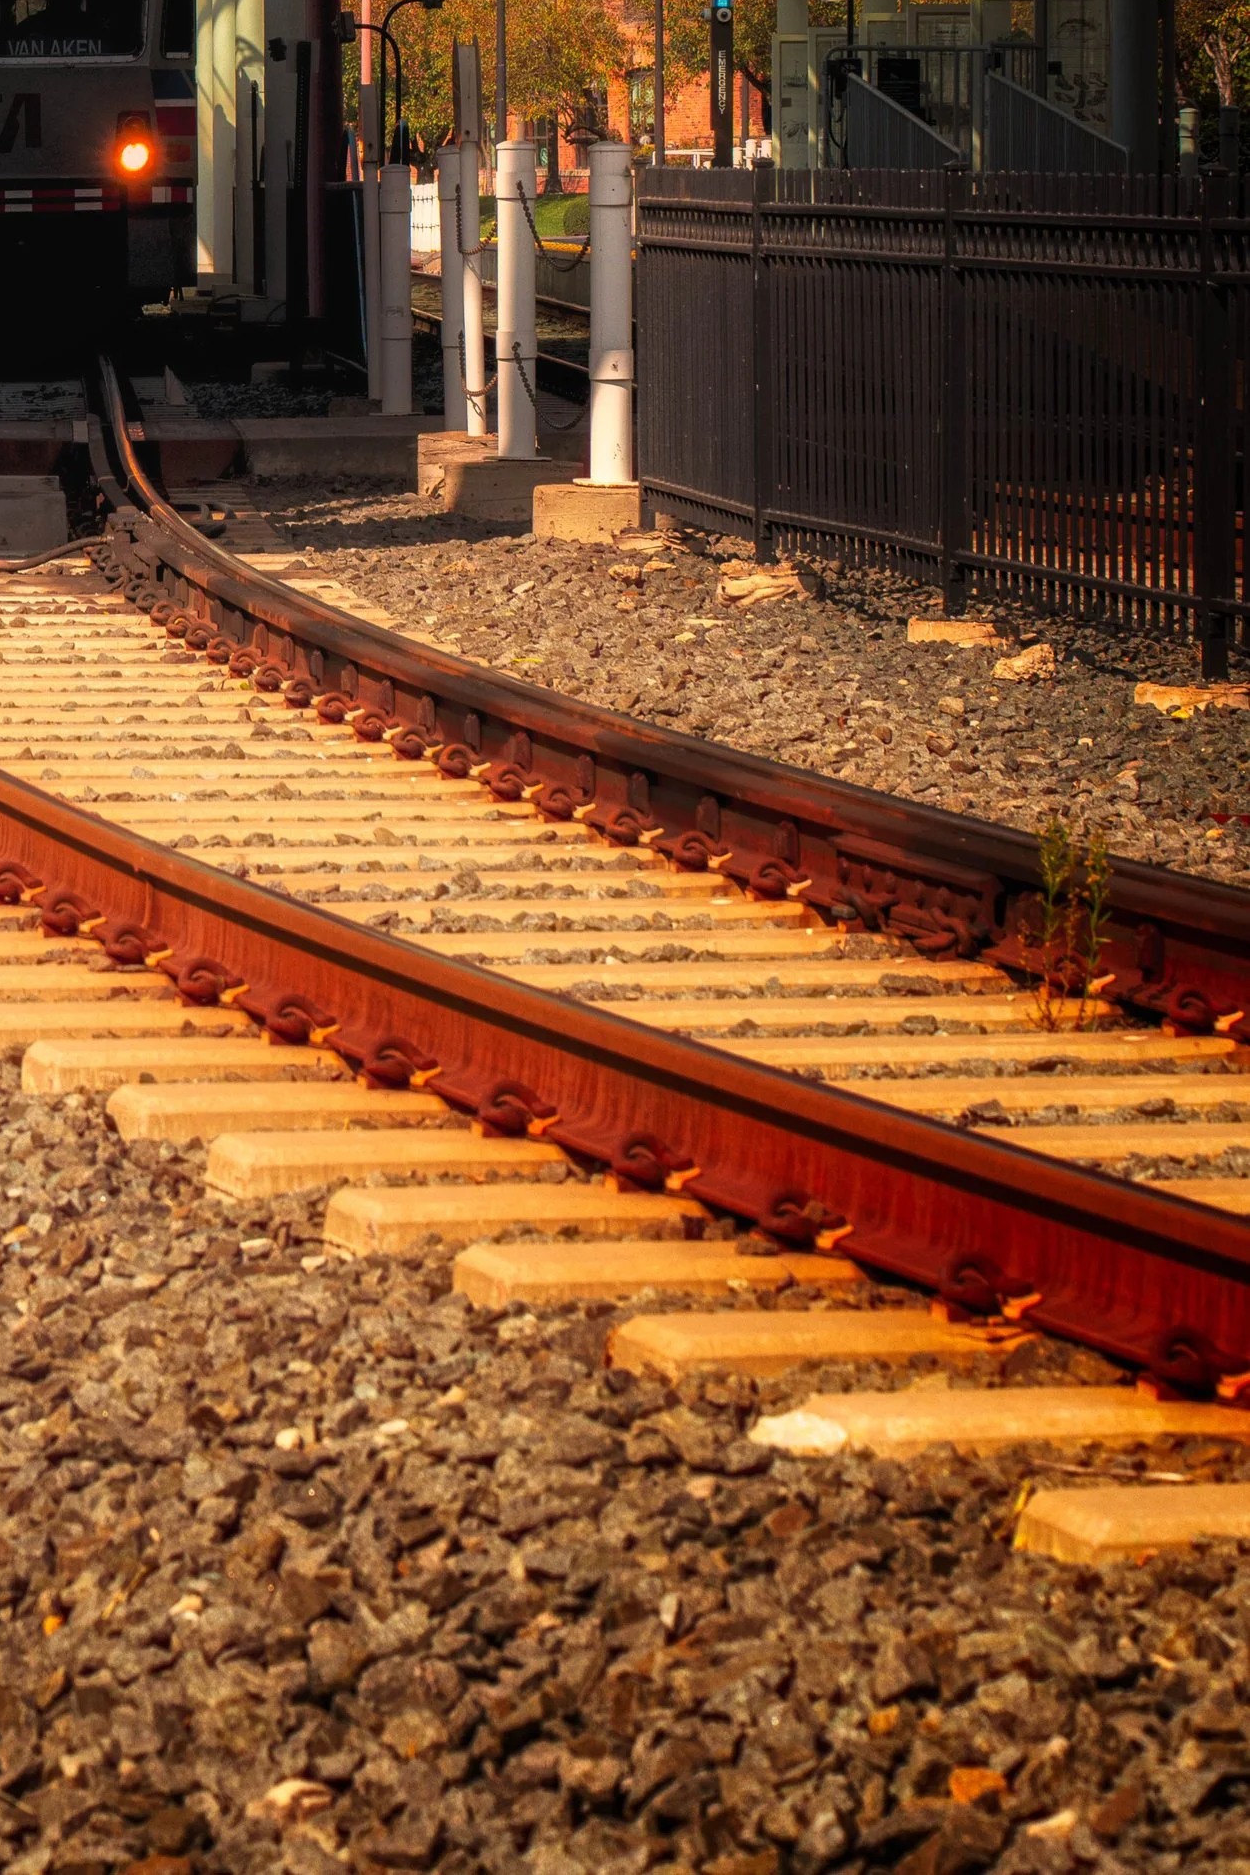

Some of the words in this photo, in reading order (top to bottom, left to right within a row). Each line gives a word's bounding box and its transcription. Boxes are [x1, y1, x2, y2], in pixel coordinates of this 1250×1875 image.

[8, 39, 45, 56] VAN
[50, 38, 102, 56] AKEN
[718, 50, 727, 115] EMERGENCY
